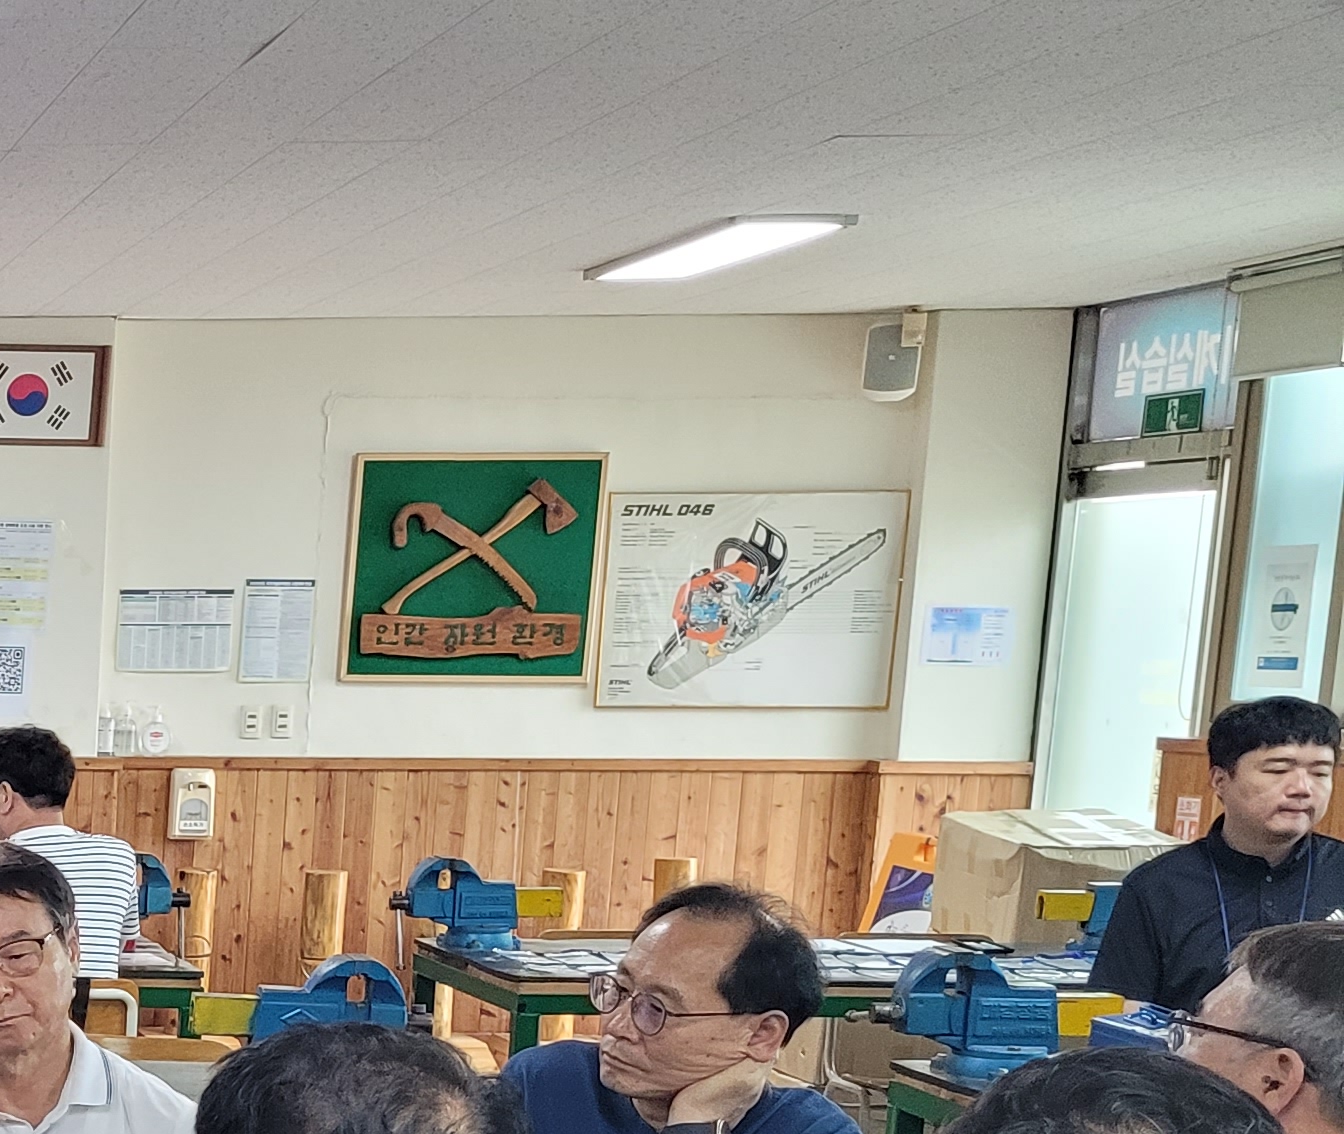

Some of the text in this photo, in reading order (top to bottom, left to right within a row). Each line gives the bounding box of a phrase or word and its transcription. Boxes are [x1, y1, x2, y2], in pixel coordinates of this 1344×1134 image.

[620, 503, 716, 517] STIHL 046
[801, 570, 830, 594] STIHL
[376, 622, 429, 646] 인간
[511, 621, 567, 647] 환경
